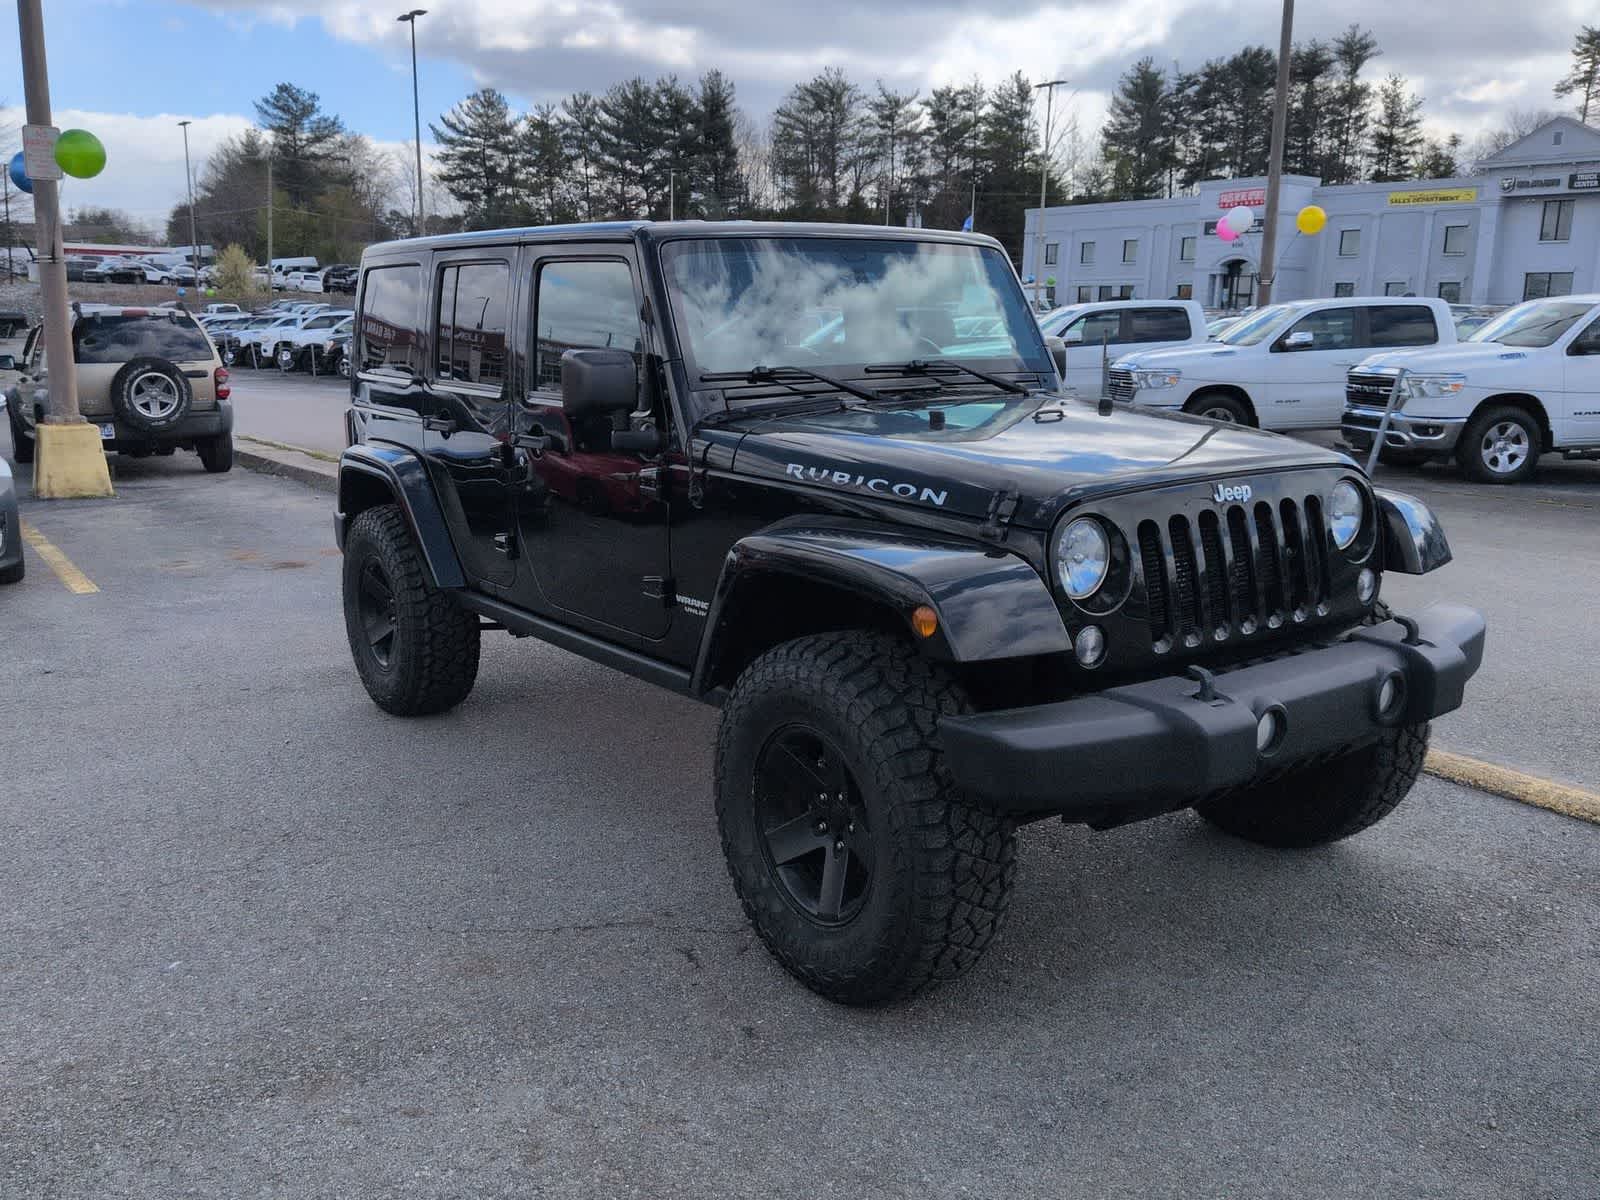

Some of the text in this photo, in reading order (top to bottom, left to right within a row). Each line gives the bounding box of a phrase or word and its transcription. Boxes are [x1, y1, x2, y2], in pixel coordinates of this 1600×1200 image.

[1574, 180, 1599, 188] CENTER
[1412, 195, 1460, 203] DEPARTMENT
[786, 463, 947, 506] RUBICON
[1214, 484, 1252, 503] Jeep
